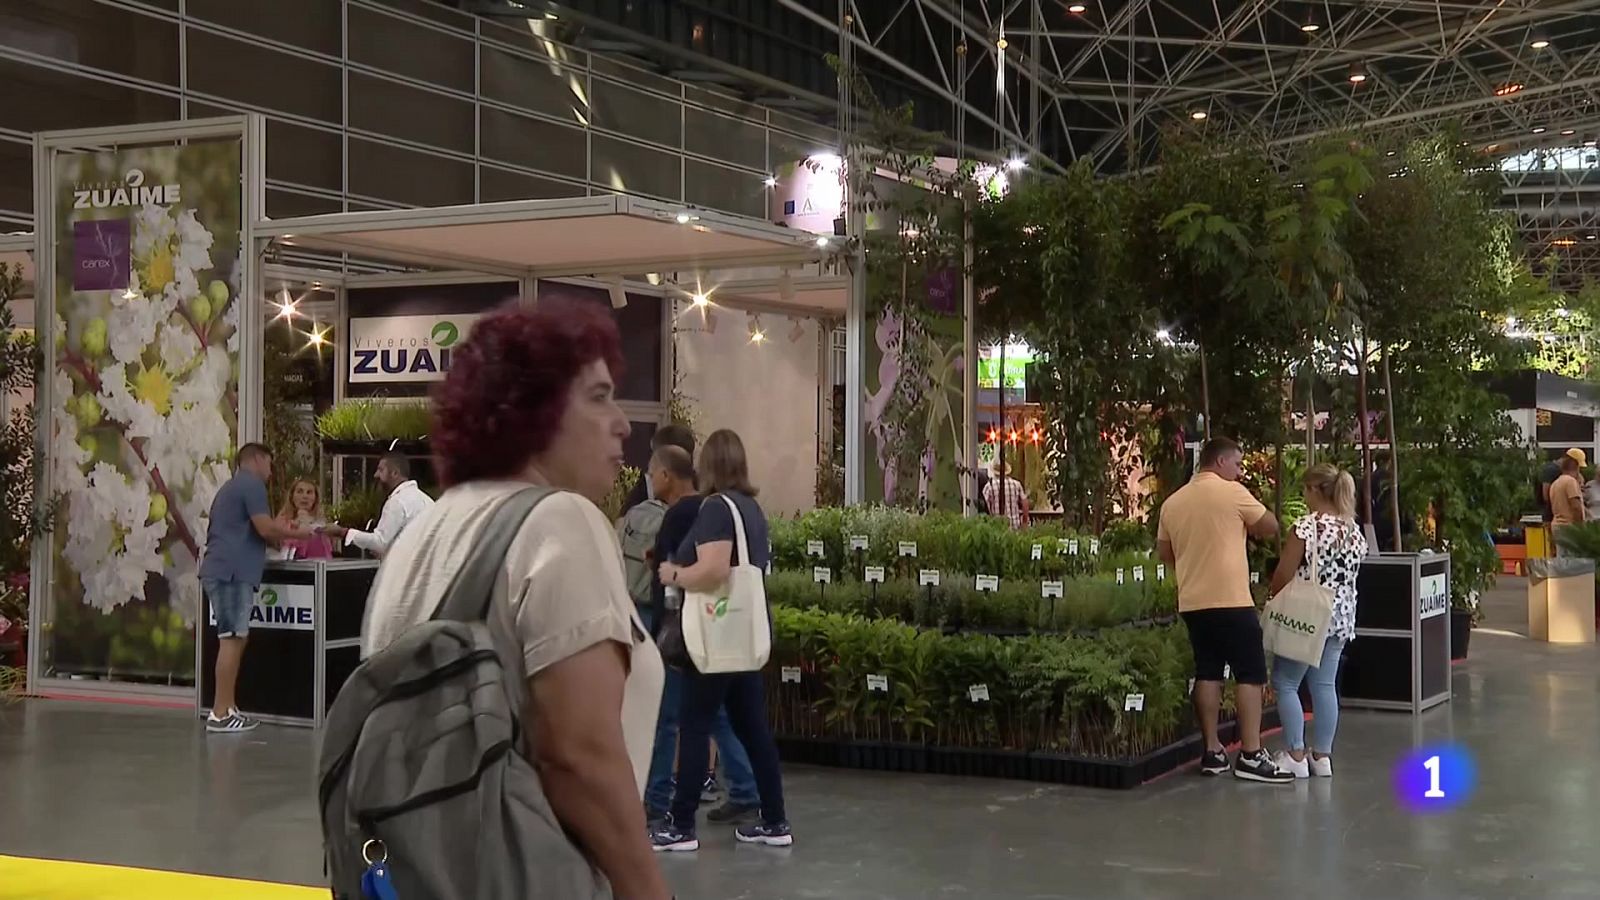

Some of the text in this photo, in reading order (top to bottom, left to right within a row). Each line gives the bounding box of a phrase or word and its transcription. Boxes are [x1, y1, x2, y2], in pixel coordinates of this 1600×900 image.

[74, 184, 180, 209] ZUAIME
[82, 259, 111, 269] carex
[354, 336, 429, 348] Viveros
[353, 348, 450, 374] ZUAI
[1420, 593, 1445, 614] ZUAIME
